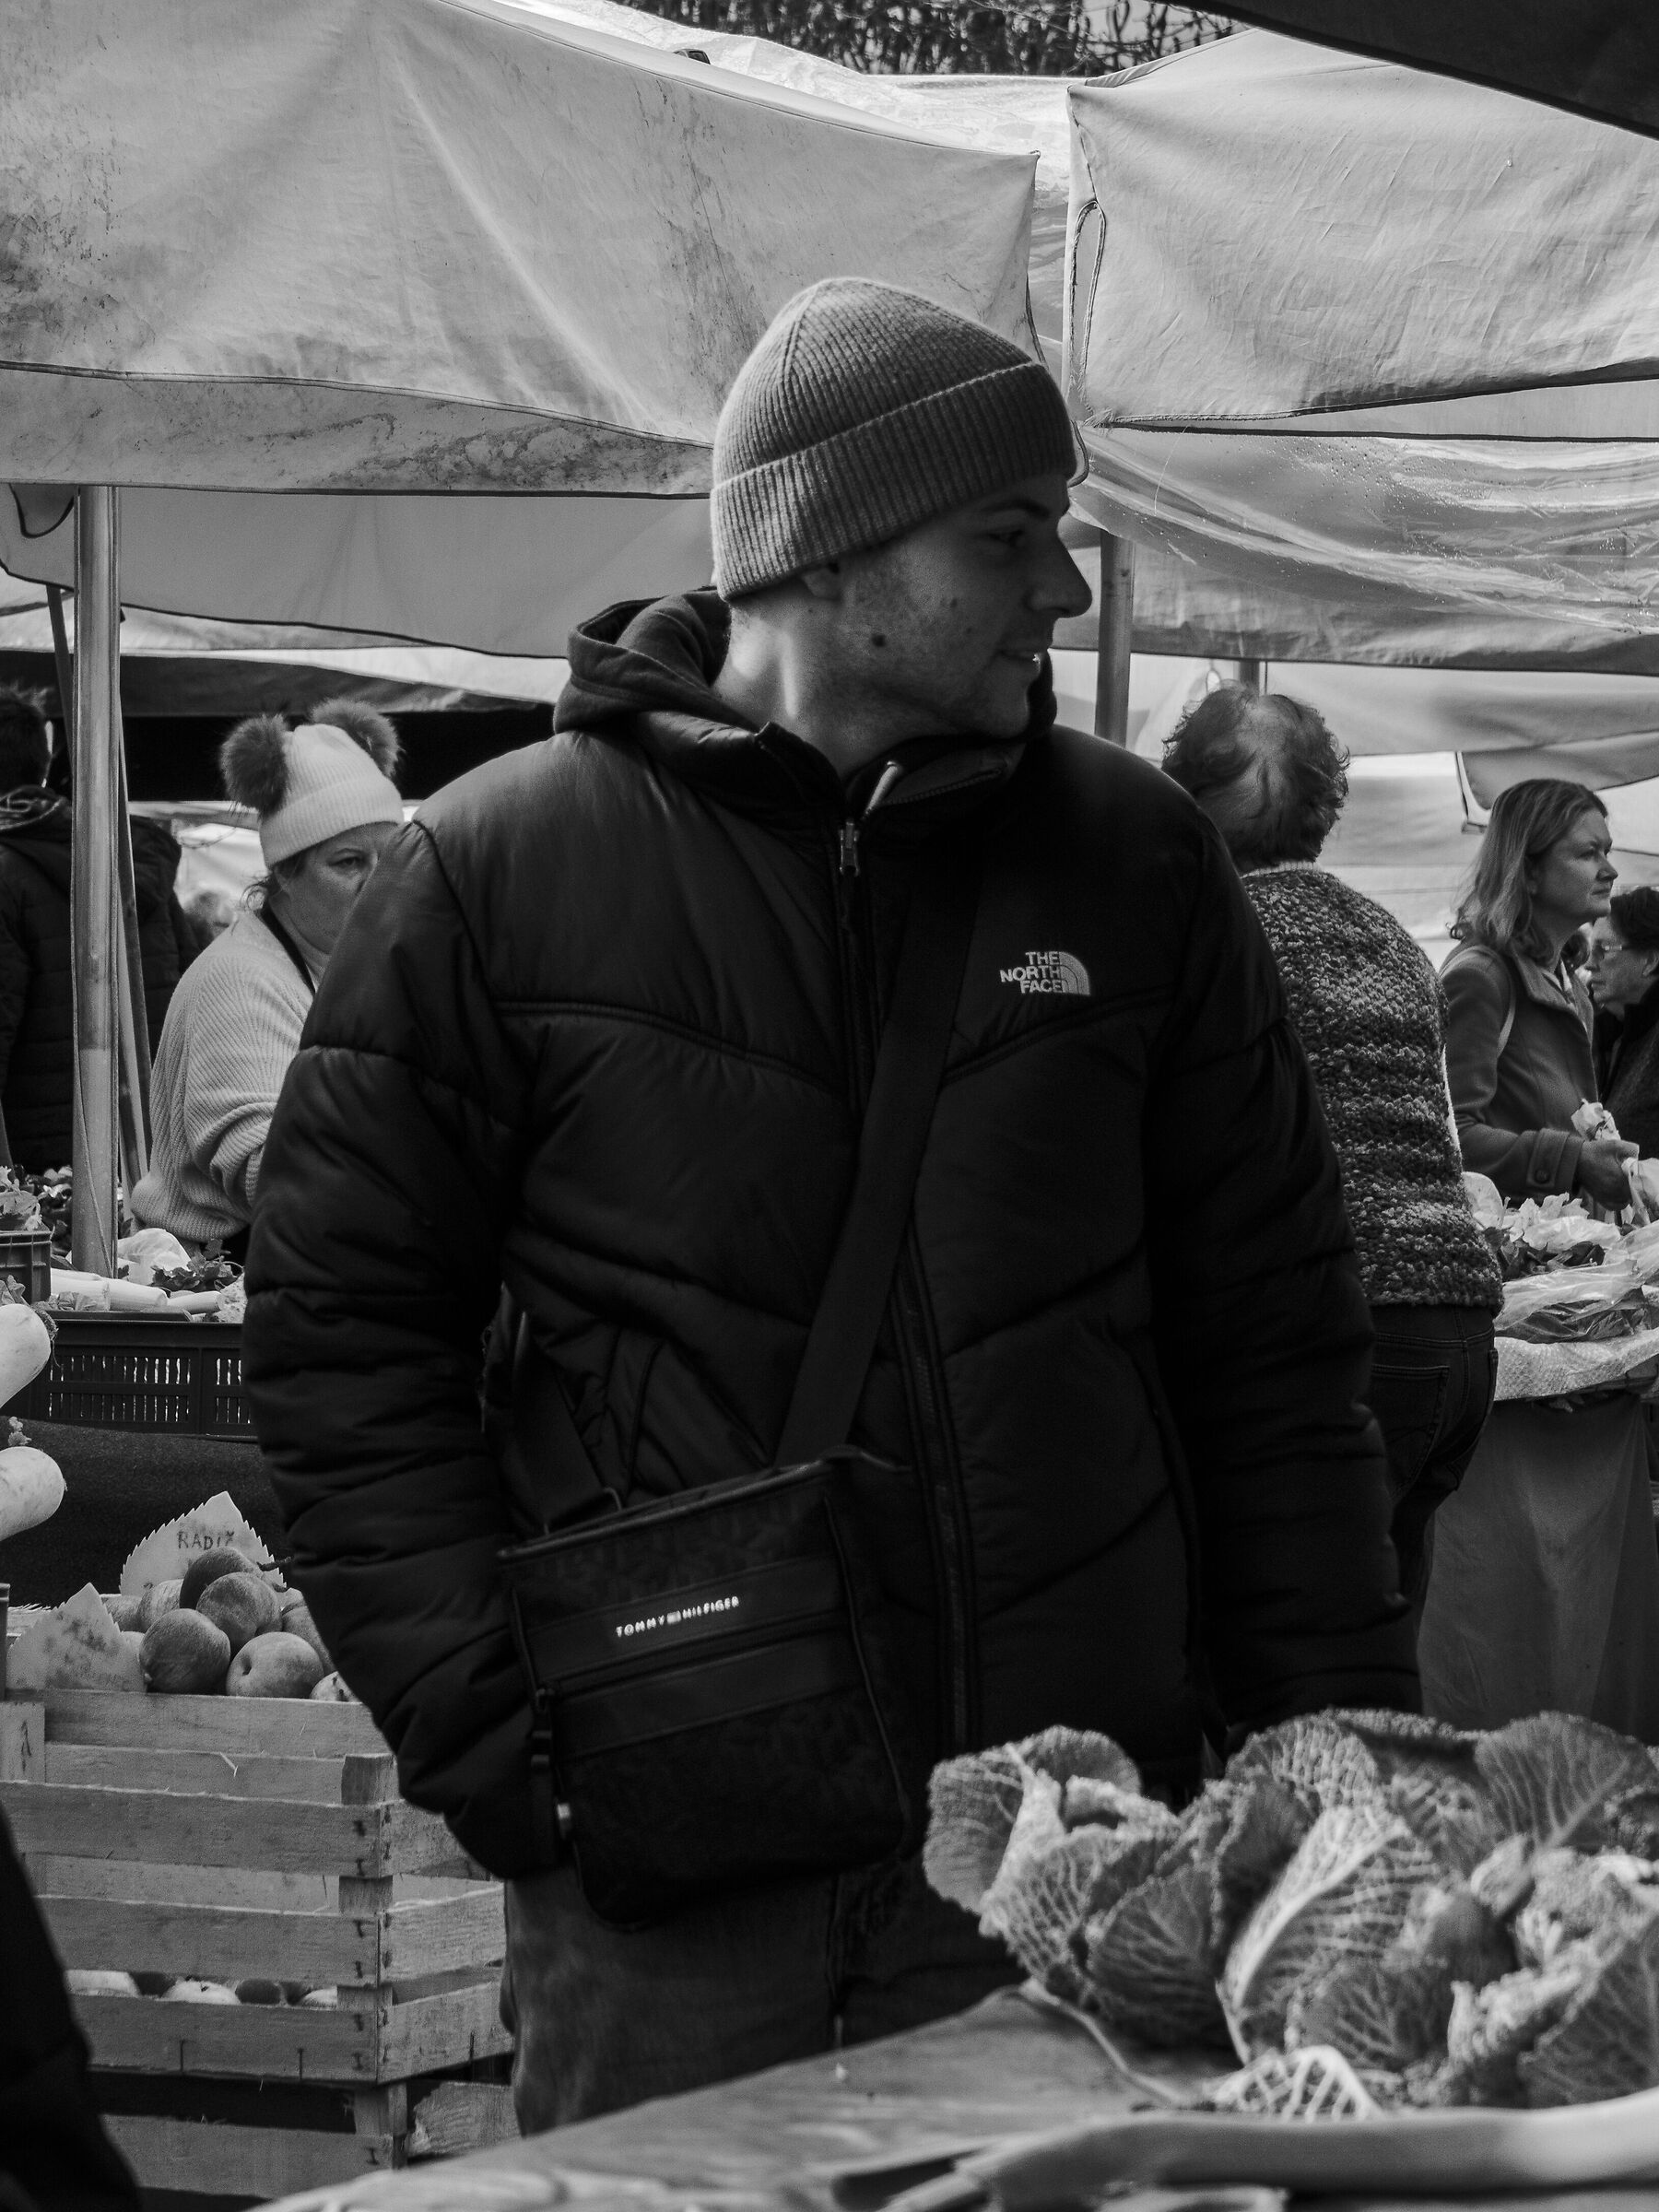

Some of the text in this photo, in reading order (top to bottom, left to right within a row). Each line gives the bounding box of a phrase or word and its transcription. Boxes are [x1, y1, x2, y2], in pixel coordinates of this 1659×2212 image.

[1025, 951, 1060, 965] THE
[1000, 965, 1061, 982] NORTH
[1020, 979, 1063, 994] FACE
[616, 1615, 665, 1637] TOMMY
